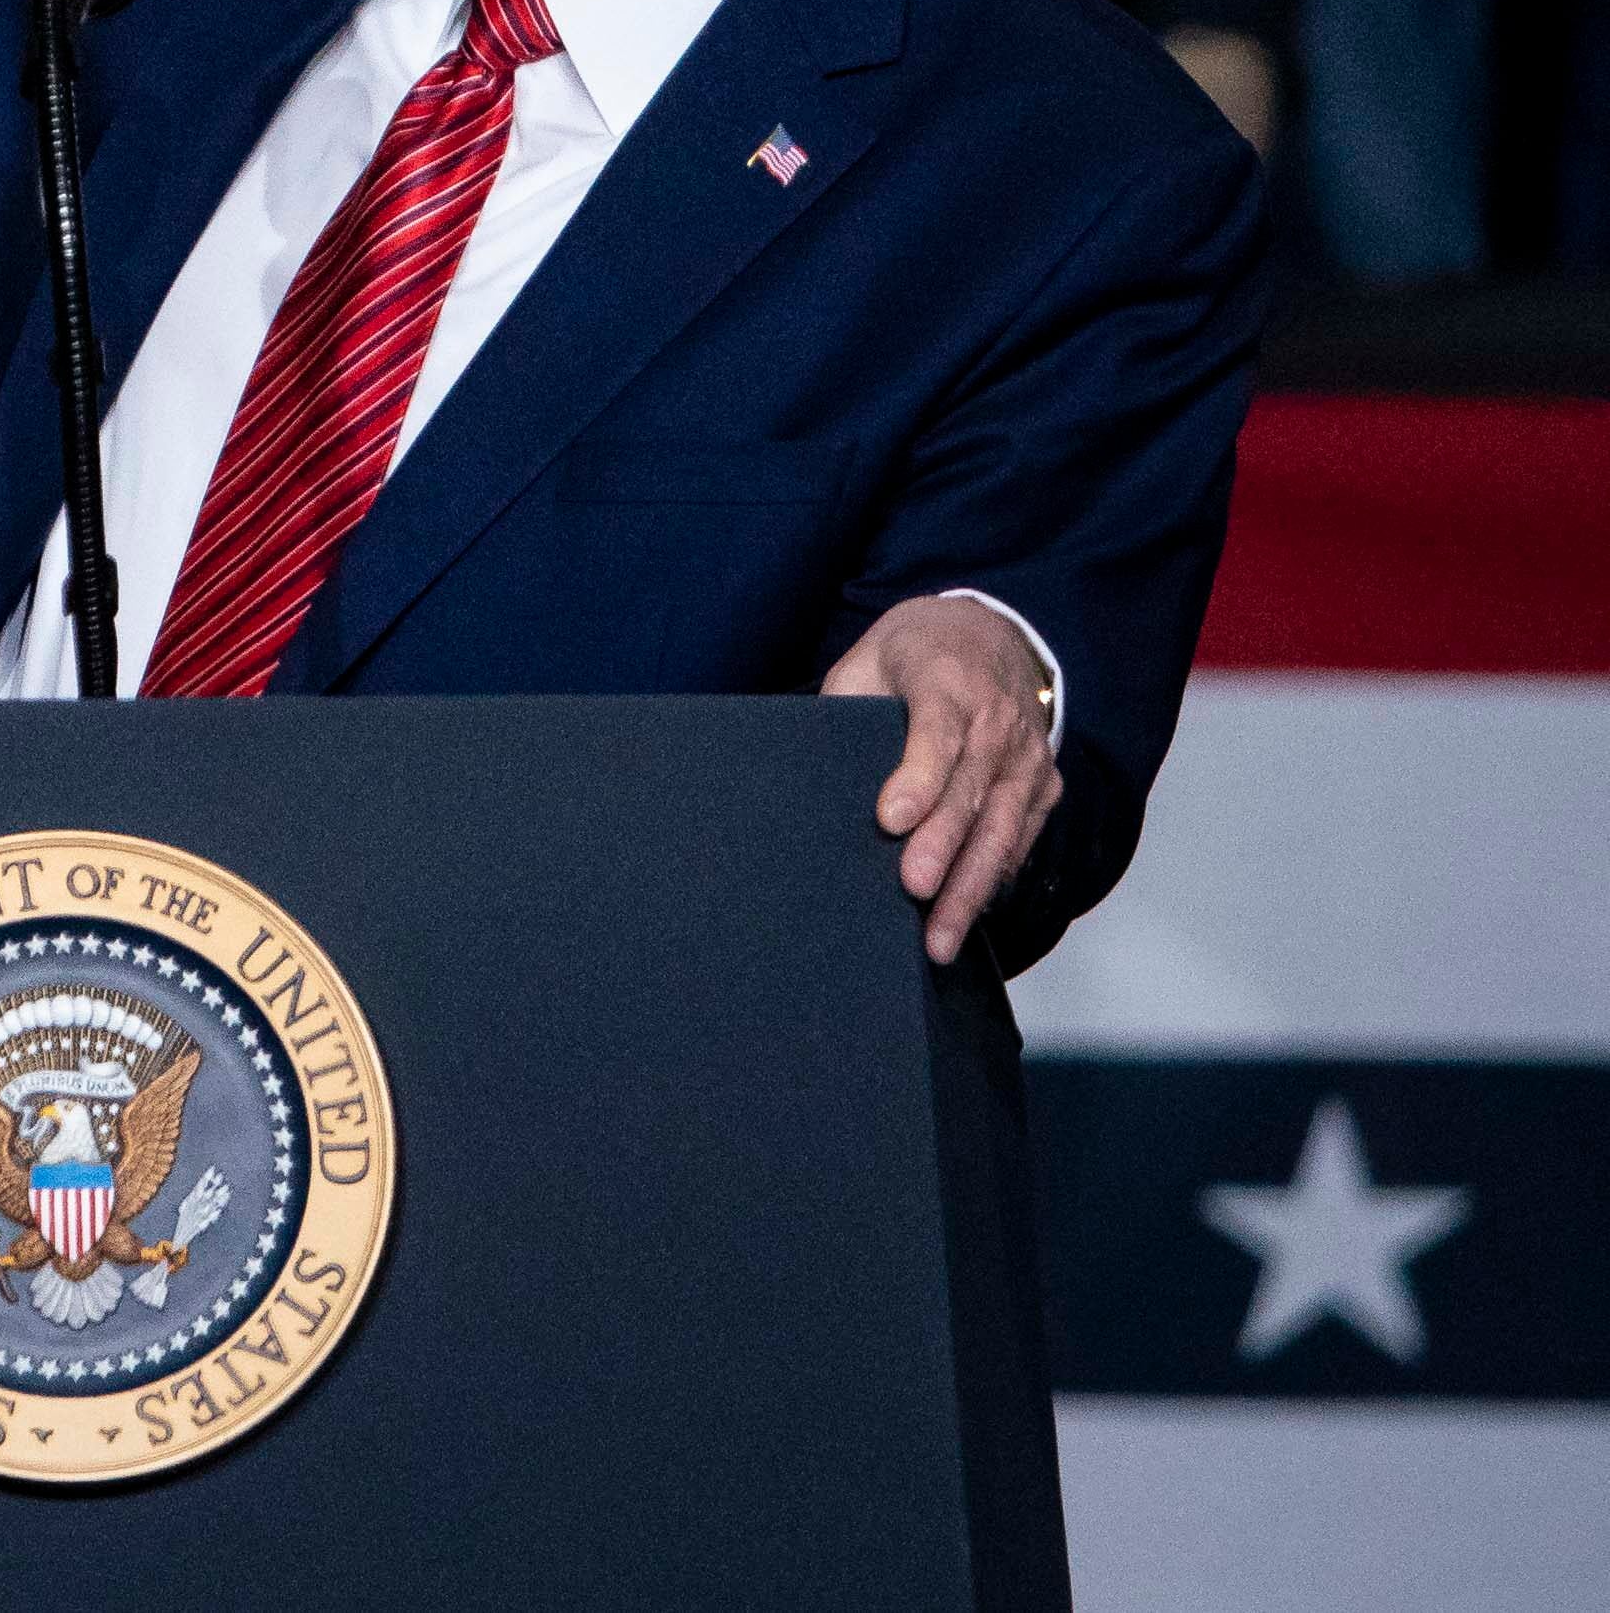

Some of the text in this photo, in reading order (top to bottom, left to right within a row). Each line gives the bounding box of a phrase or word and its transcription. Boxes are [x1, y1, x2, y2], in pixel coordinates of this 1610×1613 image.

[65, 863, 125, 900] OF
[140, 874, 219, 935] THE
[236, 925, 371, 1186] UNITED
[134, 1247, 347, 1447] STATES
